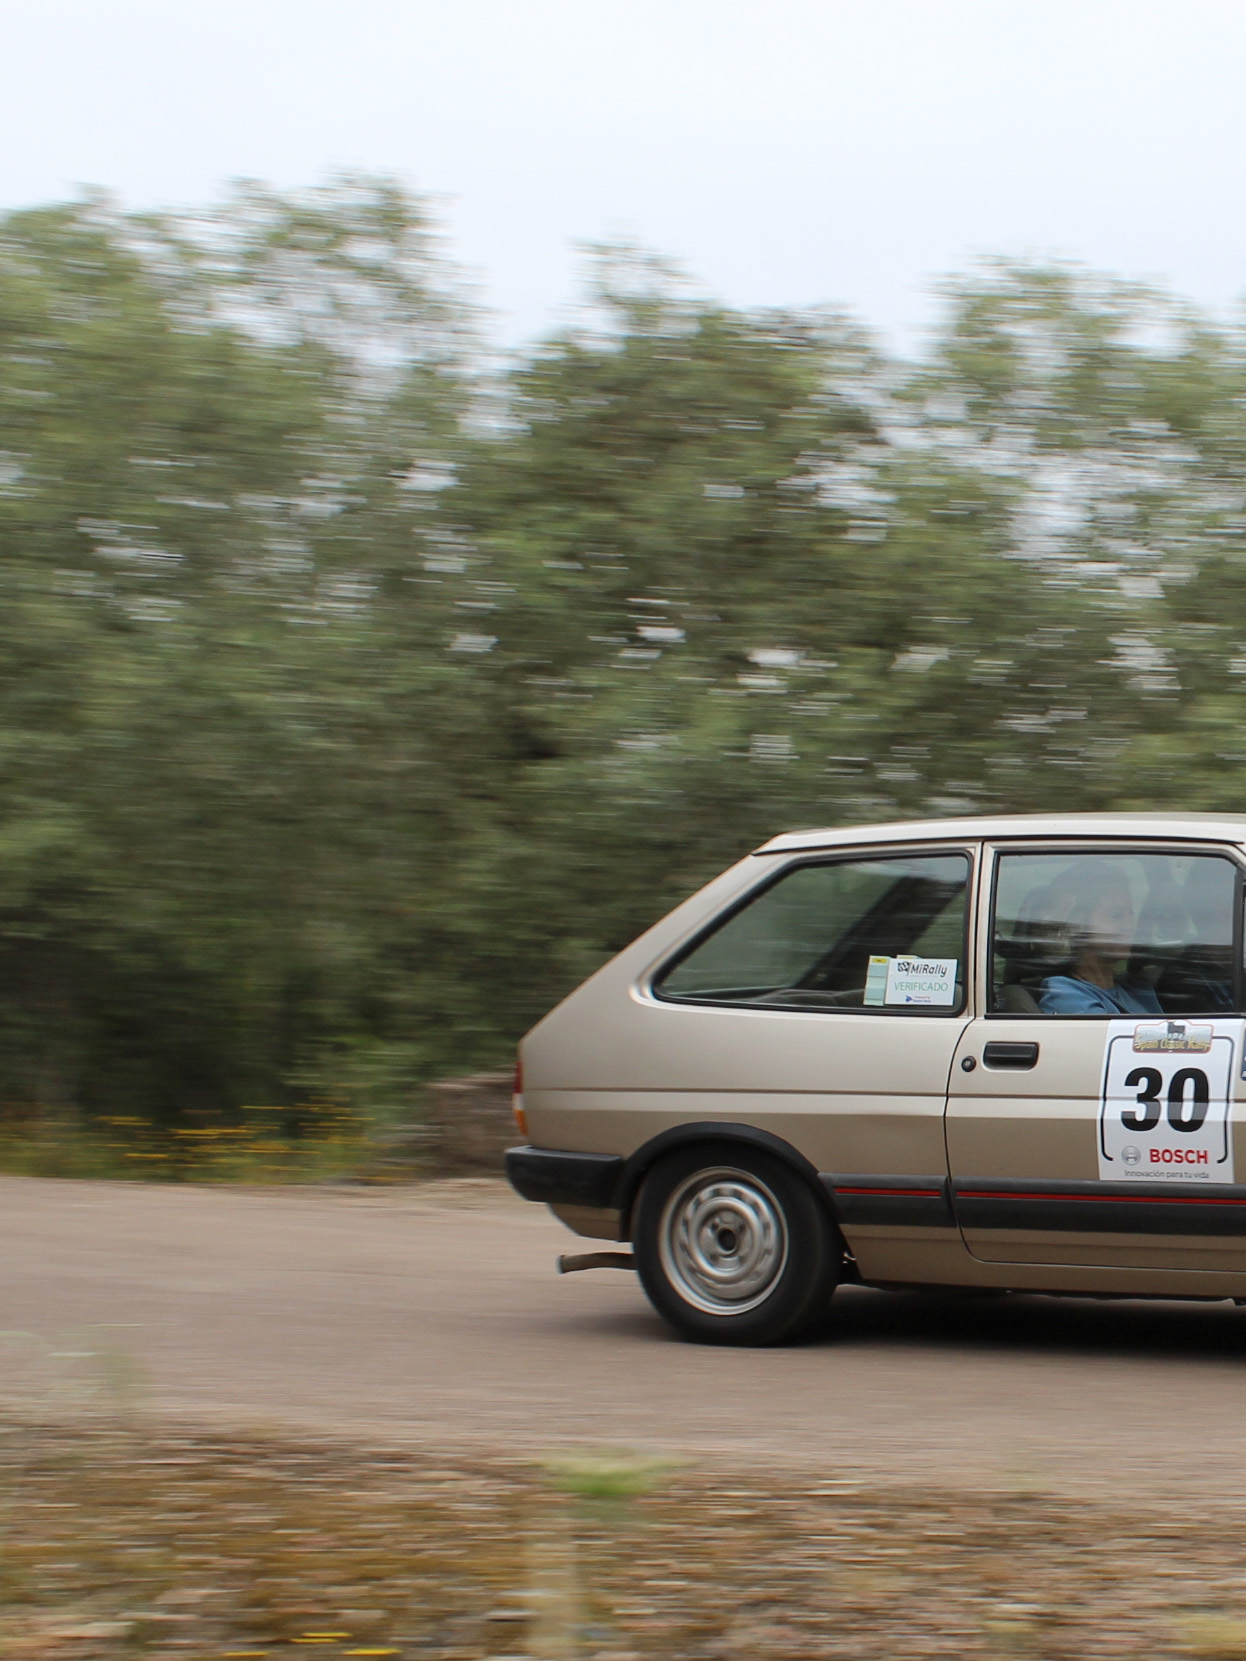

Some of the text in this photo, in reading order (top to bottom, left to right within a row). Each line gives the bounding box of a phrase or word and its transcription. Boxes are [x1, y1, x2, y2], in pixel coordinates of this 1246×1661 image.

[910, 964, 948, 978] MiRally
[894, 981, 949, 992] VERIFICADO
[1121, 1066, 1210, 1133] 30
[1149, 1148, 1209, 1164] BOSCH
[1124, 1169, 1165, 1178] Innovación
[1166, 1171, 1183, 1179] para
[1194, 1171, 1210, 1179] vida
